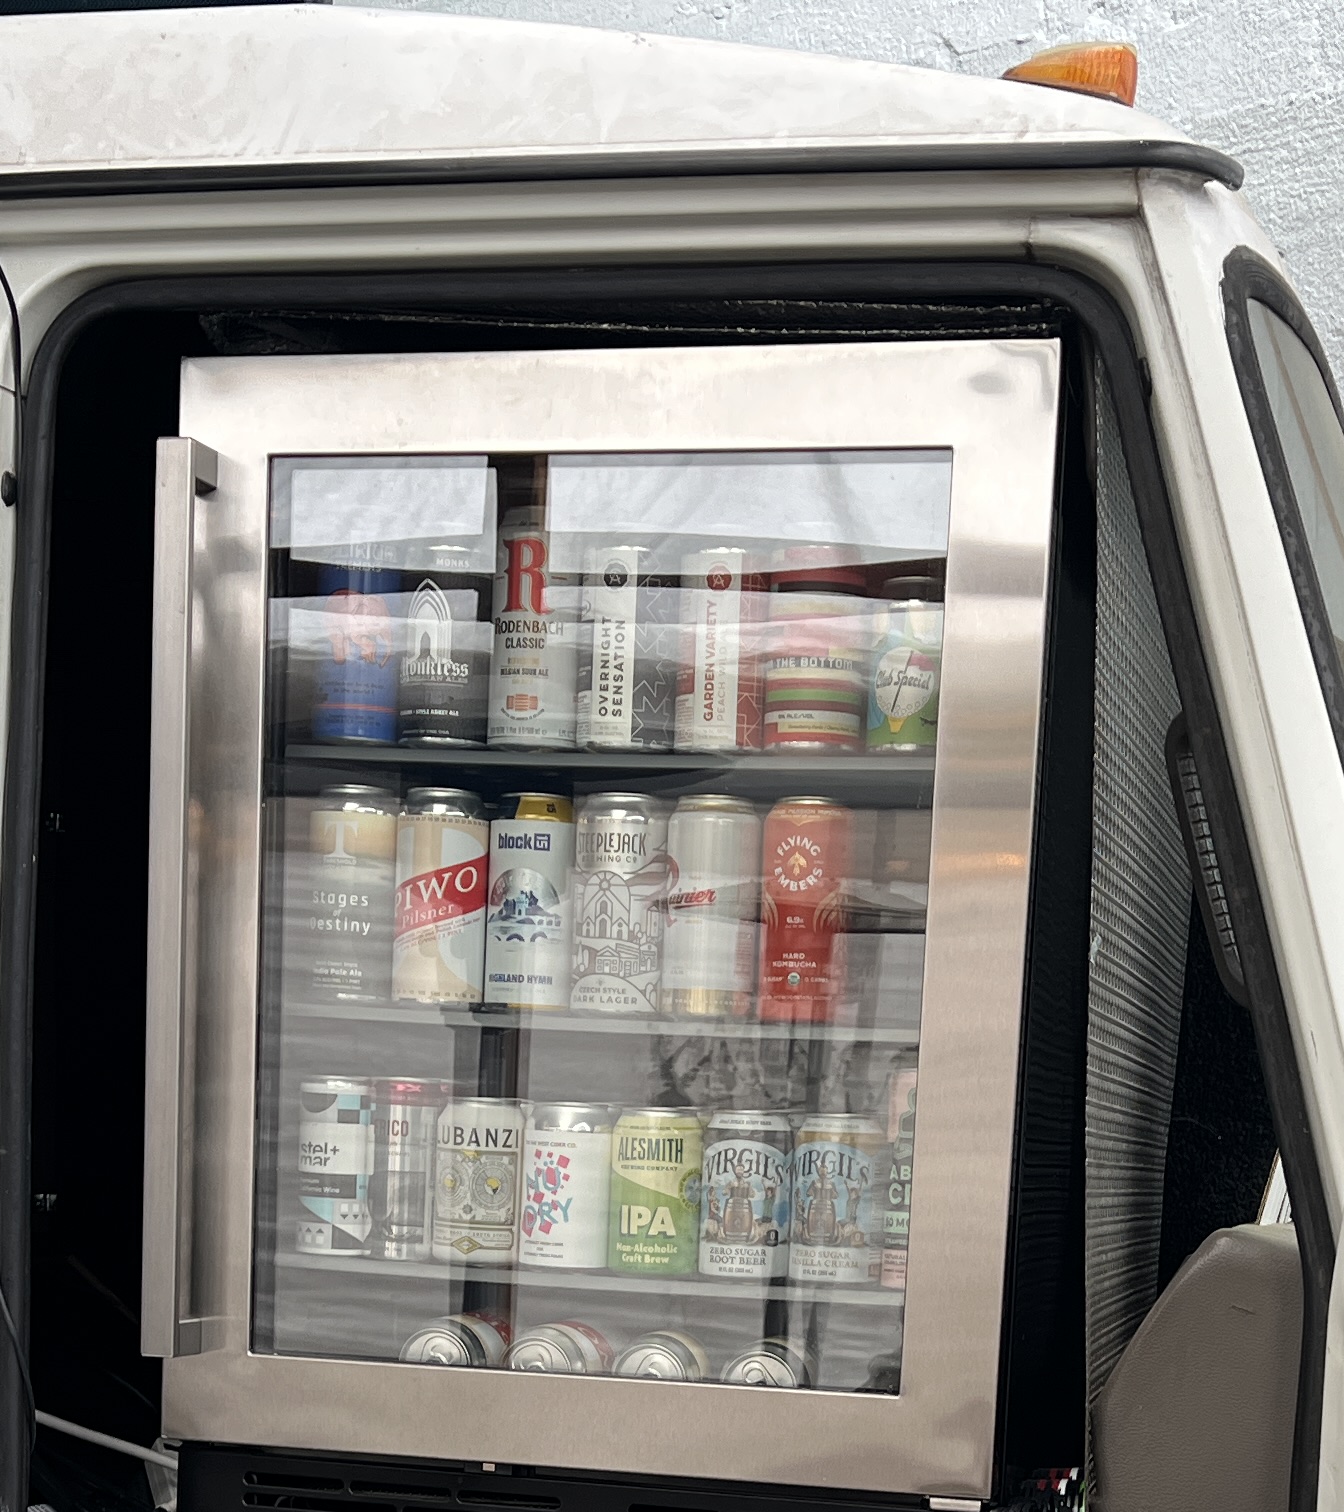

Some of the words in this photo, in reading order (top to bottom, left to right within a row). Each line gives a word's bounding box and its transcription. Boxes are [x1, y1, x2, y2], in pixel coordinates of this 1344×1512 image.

[494, 617, 564, 635] RODENBACH
[706, 599, 717, 660] VARIETY
[505, 636, 545, 649] CLASSIC
[598, 616, 612, 717] OVERNIGHT
[612, 620, 626, 717] SENSATION
[776, 657, 796, 668] THE
[801, 657, 853, 670] BOTTOM
[894, 669, 933, 690] Special
[703, 663, 715, 721] GARDEN
[498, 833, 532, 850] block
[578, 831, 647, 857] STEEPLEJACK
[777, 835, 821, 857] FLYING
[774, 866, 823, 891] EMBERS
[312, 890, 369, 908] Stages
[401, 903, 455, 929] Pilsner
[309, 917, 371, 936] Destiny
[574, 994, 595, 1004] DARK
[599, 995, 638, 1006] LAGER
[603, 987, 627, 996] STYLE
[437, 1126, 519, 1148] UBANZI
[618, 1136, 684, 1164] ALESMITH
[300, 1157, 330, 1167] mar
[705, 1147, 784, 1184] VIRGIL'S
[787, 1149, 869, 1185] VIRGIL'S
[524, 1197, 573, 1230] DRY
[620, 1204, 677, 1238] IPA
[616, 1242, 678, 1254] Non-Alcoholic
[709, 1247, 732, 1256] ZERO
[734, 1248, 766, 1257] SUGAR
[818, 1250, 850, 1259] SUGAR
[621, 1253, 642, 1263] Craft
[644, 1253, 669, 1264] Brew
[709, 1255, 736, 1265] ROOT
[739, 1256, 766, 1266] BEER
[824, 1260, 859, 1269] CREAM
